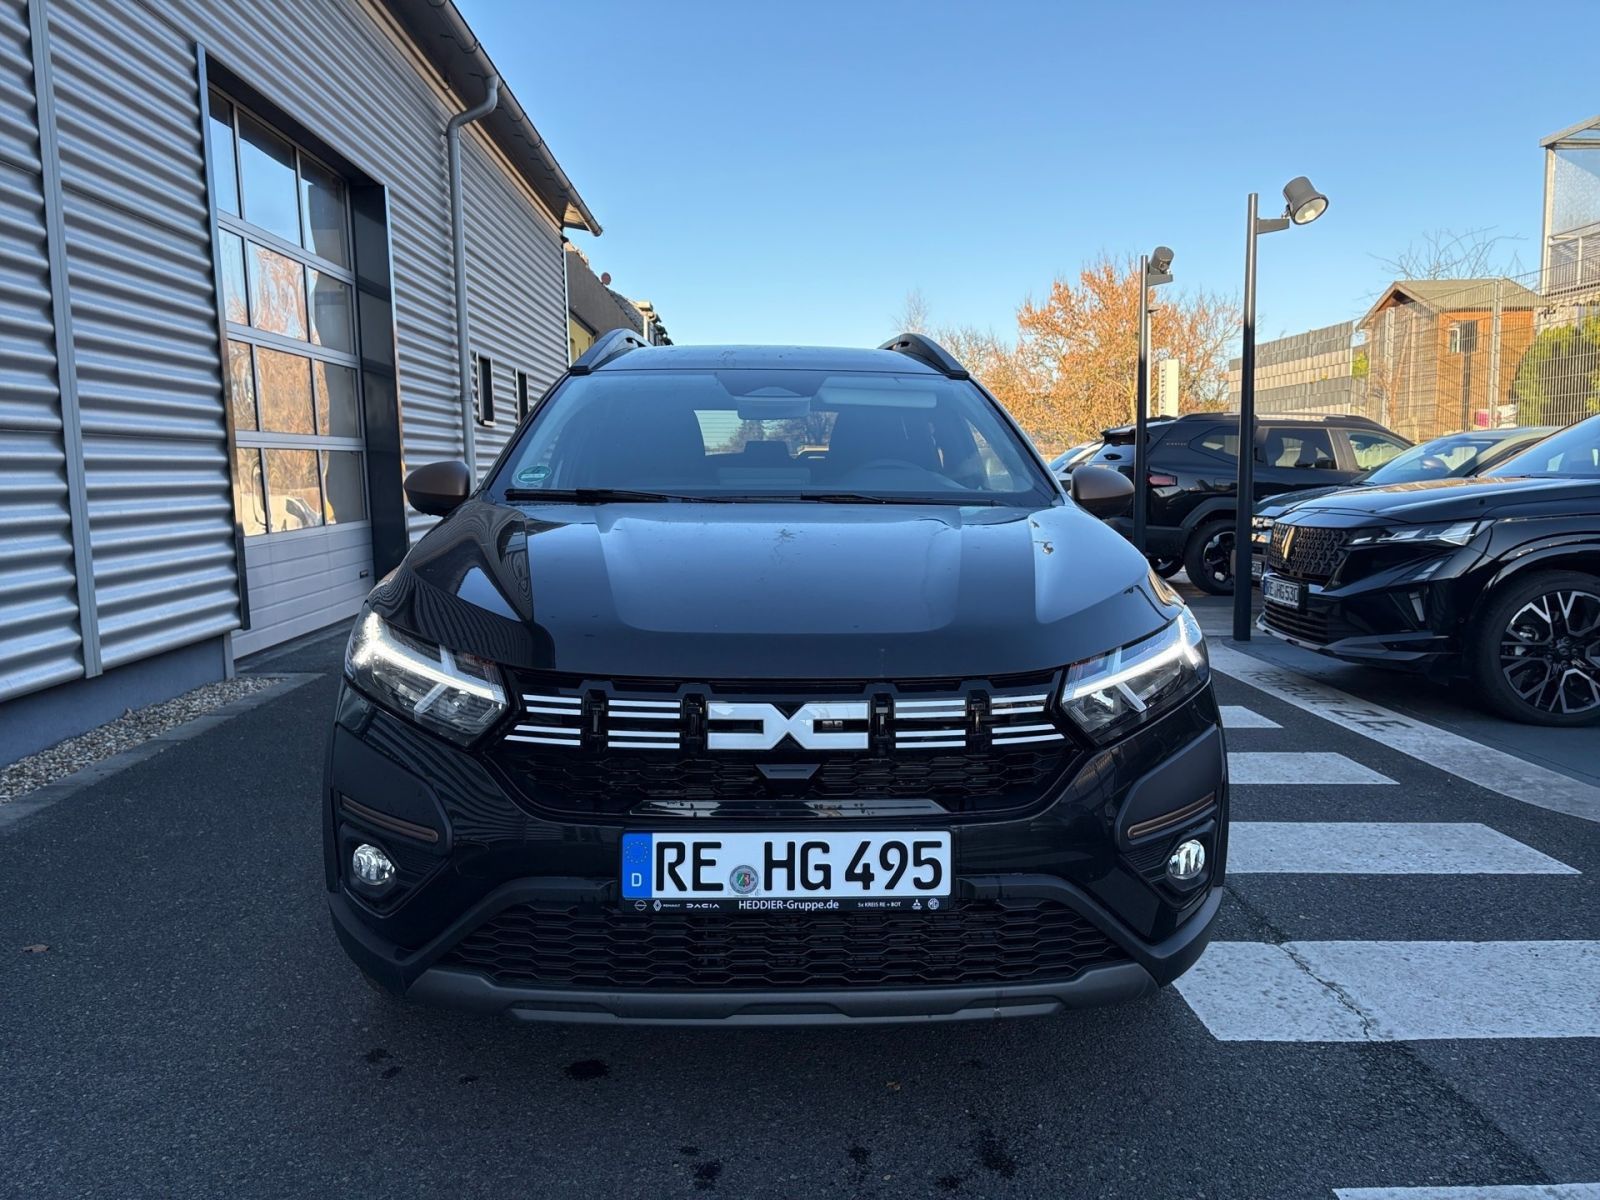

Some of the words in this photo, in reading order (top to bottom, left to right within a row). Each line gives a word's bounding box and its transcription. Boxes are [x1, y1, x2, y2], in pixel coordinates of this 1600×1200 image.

[655, 841, 724, 892] RE
[763, 841, 832, 892] HG
[844, 840, 943, 891] 495
[631, 872, 643, 887] D
[738, 899, 840, 912] HEDDIER-Gruppe.de
